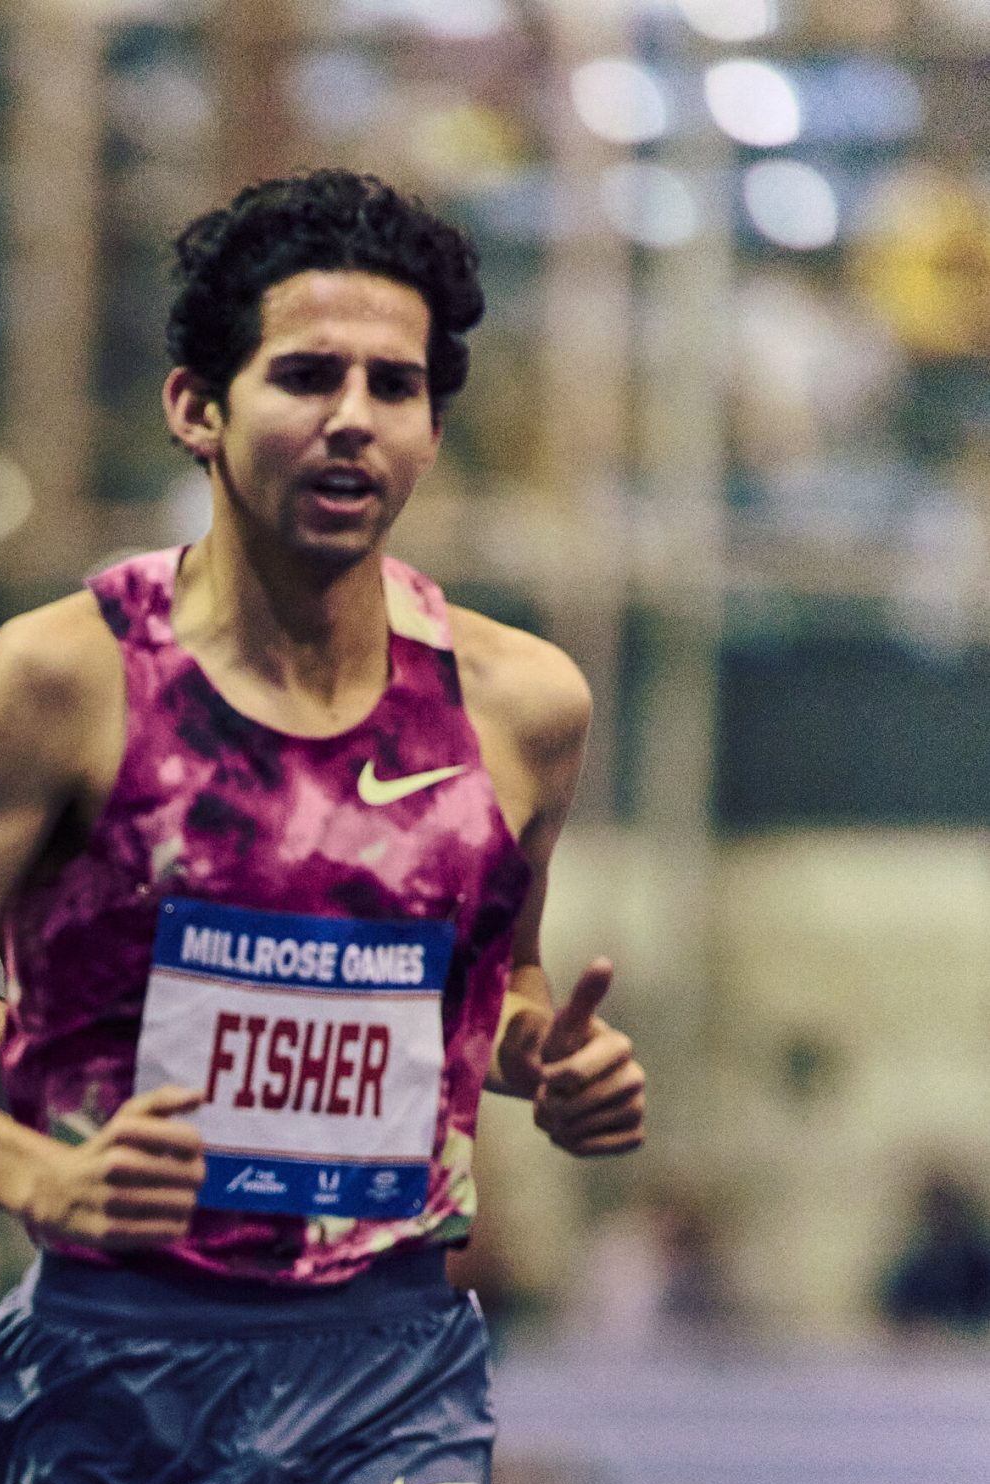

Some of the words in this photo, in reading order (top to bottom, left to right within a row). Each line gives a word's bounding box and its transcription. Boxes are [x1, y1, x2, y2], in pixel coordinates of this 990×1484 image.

[181, 925, 338, 982] MILLROSE
[341, 942, 425, 985] GAMES
[206, 1010, 391, 1118] FISHER
